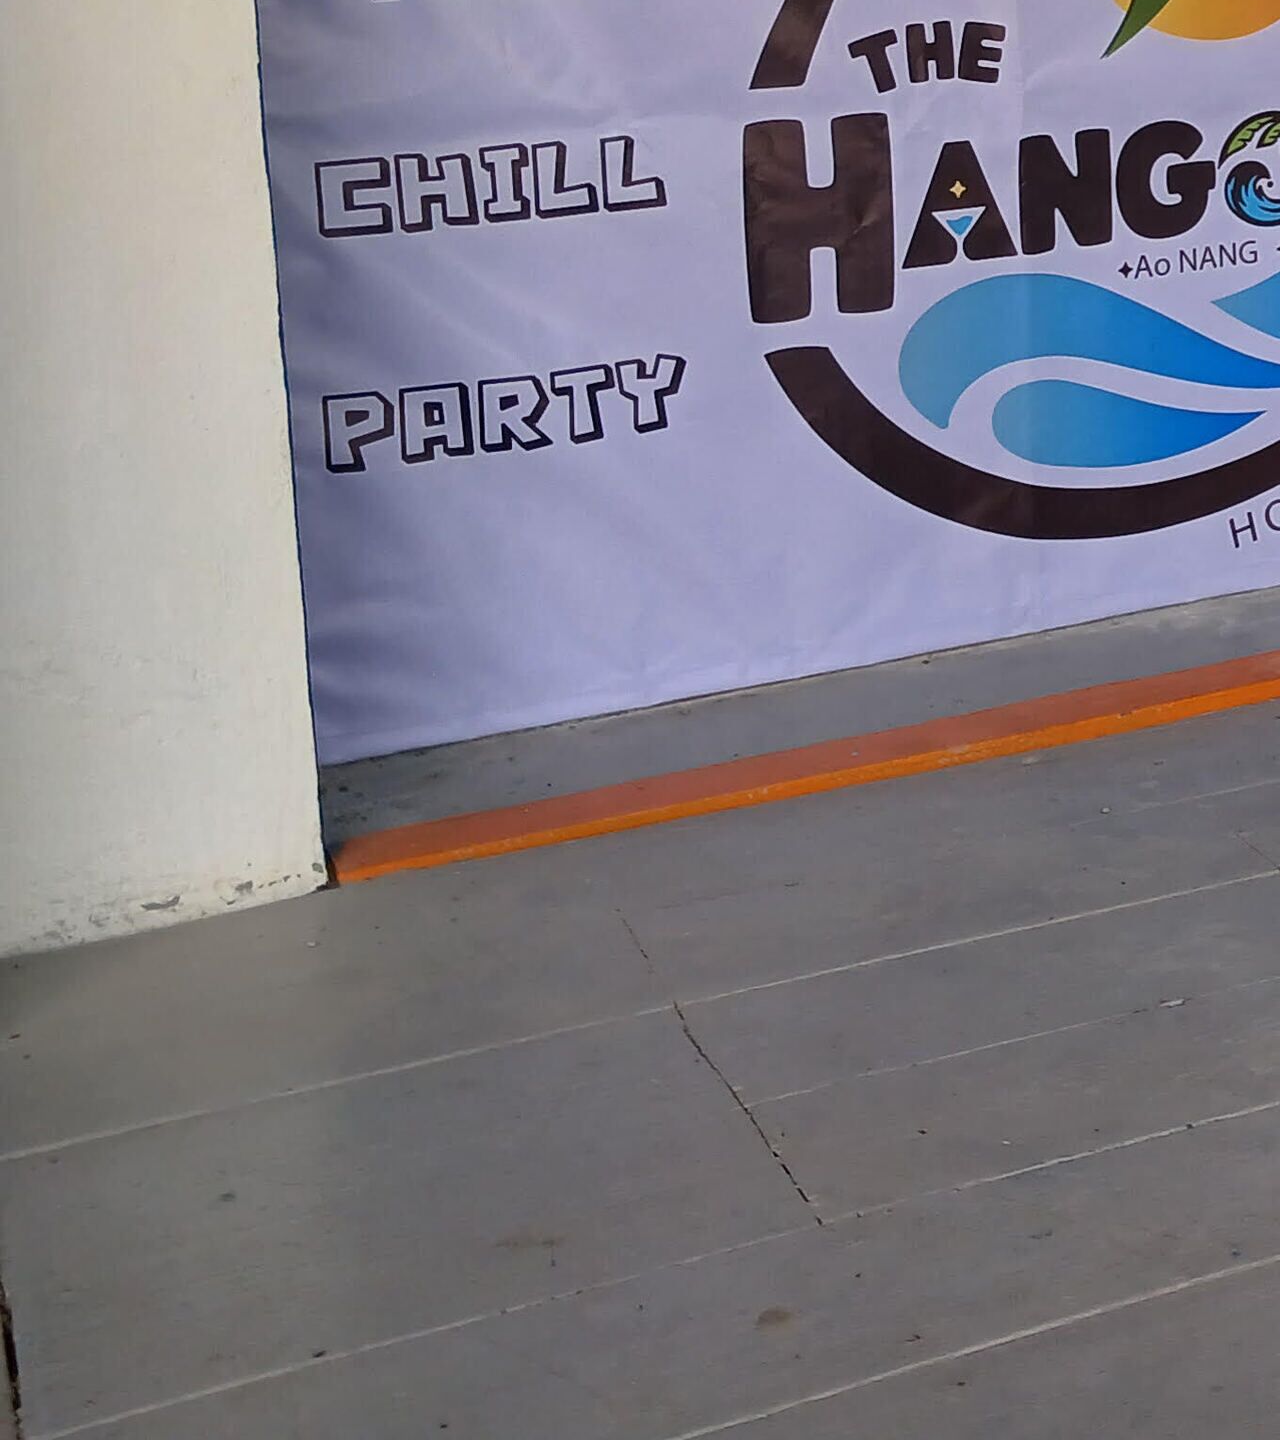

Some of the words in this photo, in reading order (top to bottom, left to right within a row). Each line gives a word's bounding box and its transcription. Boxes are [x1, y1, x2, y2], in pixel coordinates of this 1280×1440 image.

[848, 20, 1007, 93] THE
[314, 135, 668, 239] CHILL
[1134, 254, 1171, 279] Ao
[1178, 240, 1260, 274] NANG
[322, 353, 687, 474] PARTY
